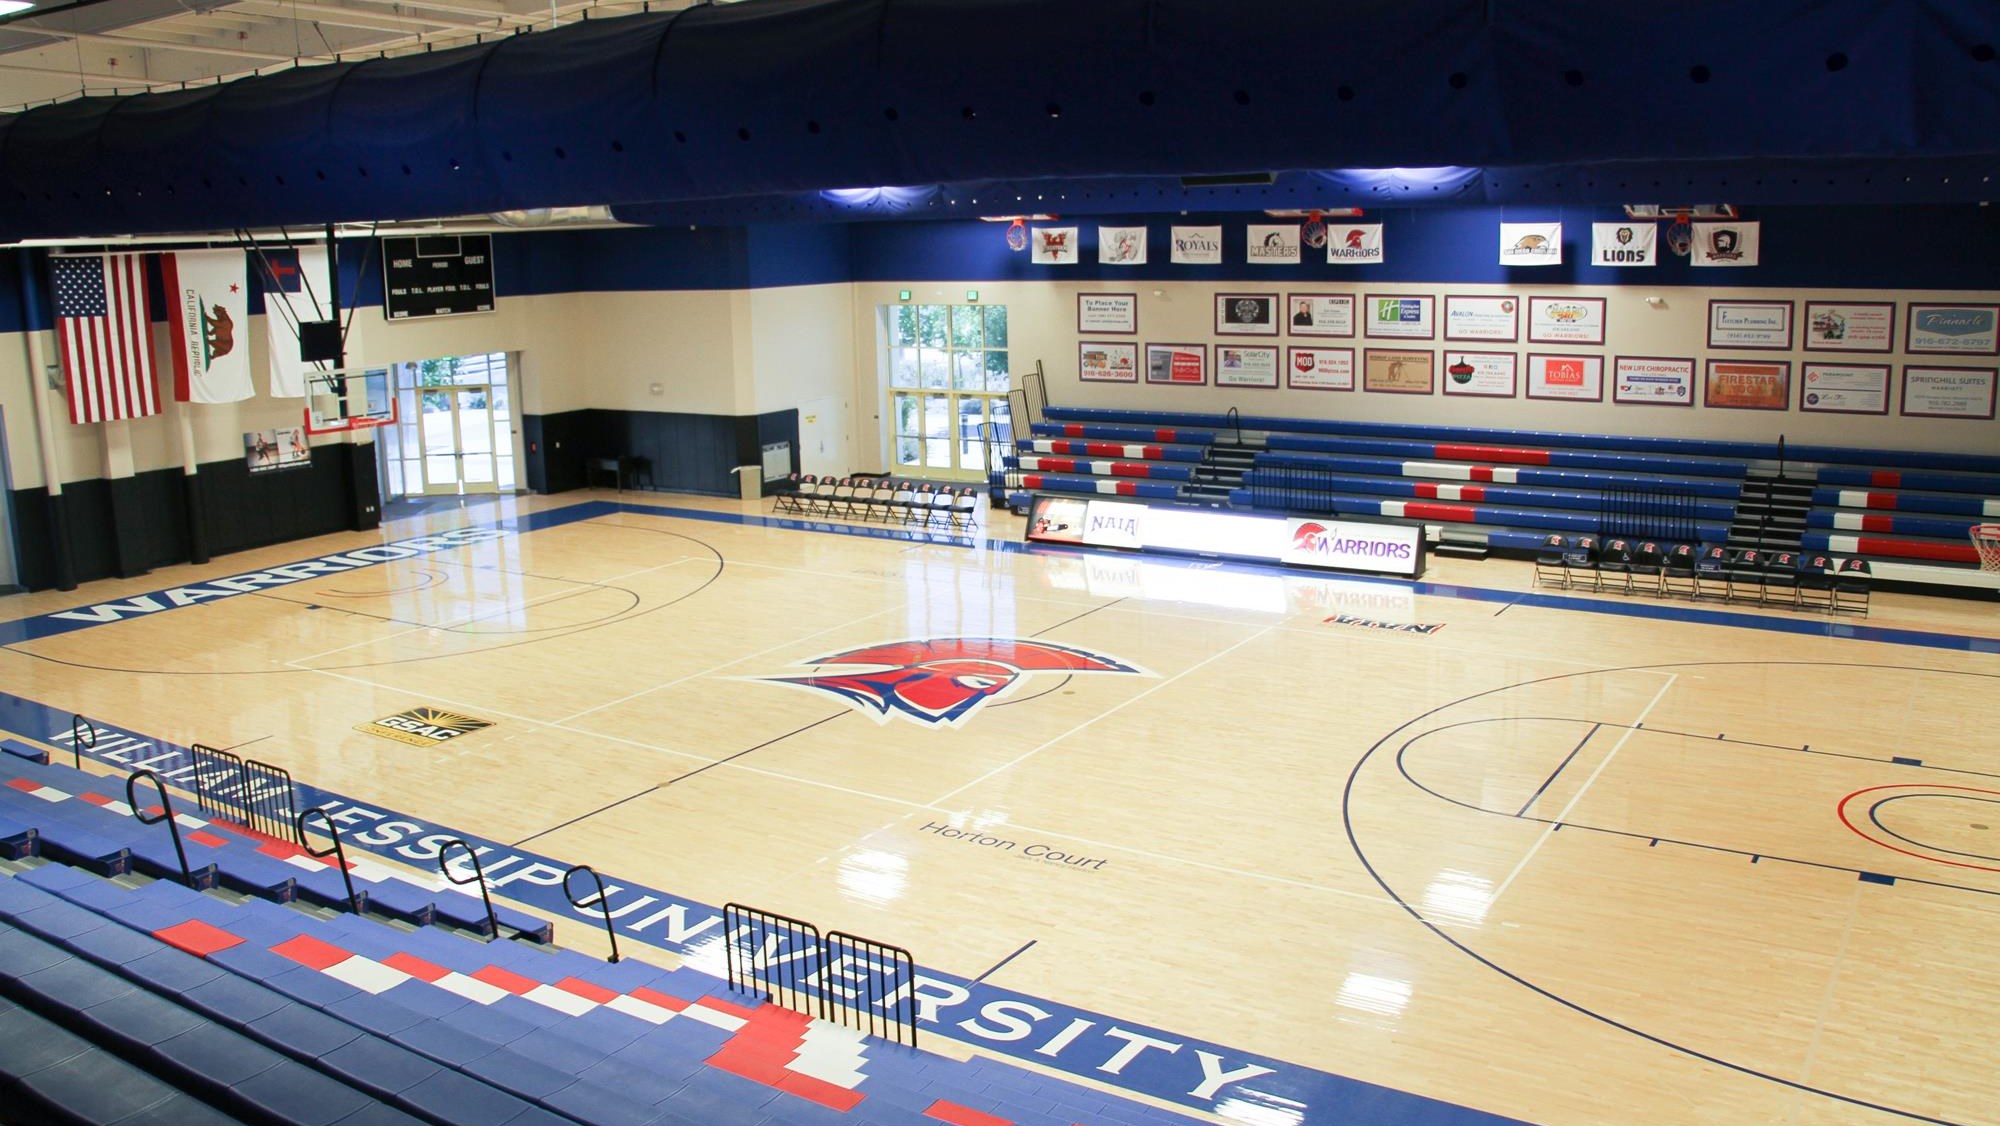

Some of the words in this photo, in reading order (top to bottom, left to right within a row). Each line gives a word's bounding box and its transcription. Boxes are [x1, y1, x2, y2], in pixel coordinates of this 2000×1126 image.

[1176, 239, 1218, 252] ROYALS
[1330, 247, 1380, 258] WARRIORS
[1603, 250, 1646, 262] LIONS
[393, 259, 413, 268] HOME
[464, 256, 484, 265] GUEST
[186, 289, 198, 336] CALIFORNIA
[1243, 350, 1270, 359] SolarCity
[1296, 356, 1313, 367] MOD
[1548, 370, 1581, 379] TOBIAS
[1911, 376, 1957, 384] SPRINGHILL
[1959, 377, 1986, 385] SUITES
[1092, 515, 1135, 536] NAIA
[1316, 528, 1412, 559] WARRIORS
[48, 527, 511, 623] WARRIORS
[375, 716, 461, 741] GSAC
[919, 822, 1016, 851] Horton
[1023, 844, 1108, 870] Court
